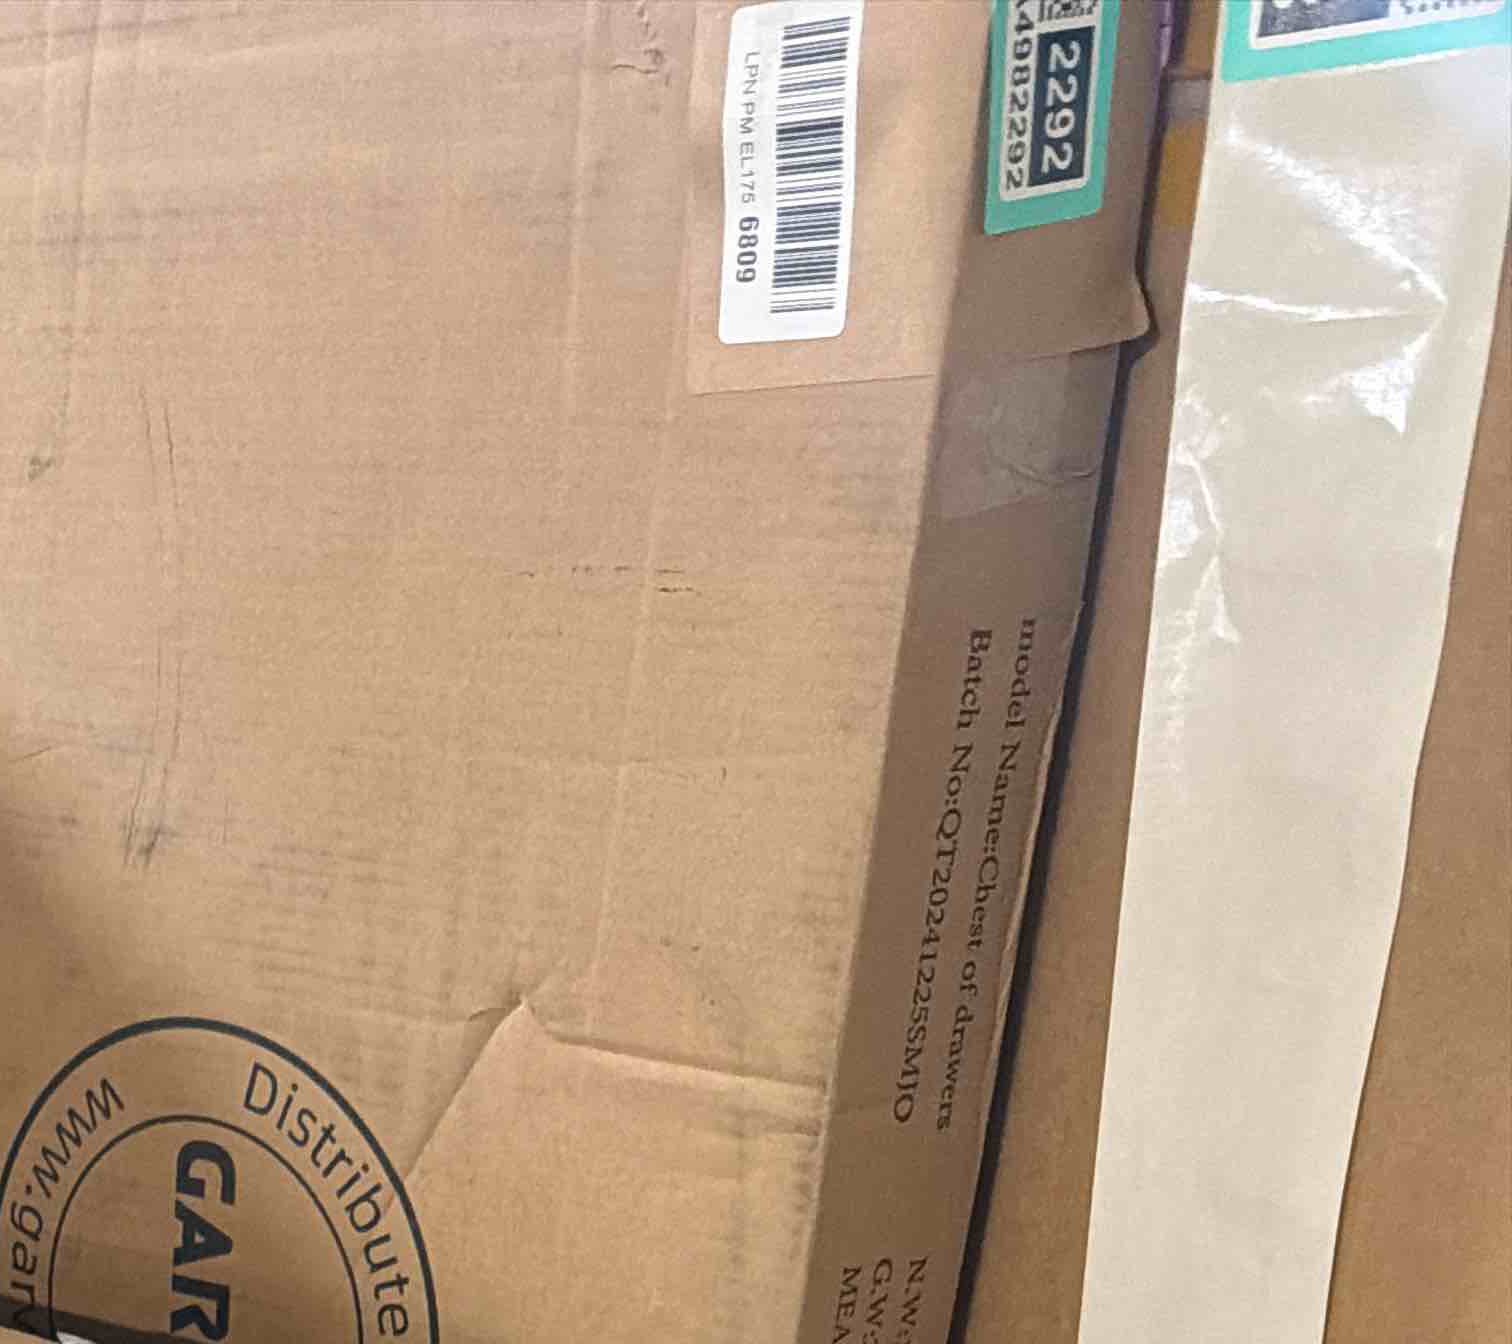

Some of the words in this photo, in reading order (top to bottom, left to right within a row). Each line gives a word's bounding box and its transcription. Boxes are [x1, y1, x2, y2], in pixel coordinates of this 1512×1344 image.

[1040, 38, 1082, 175] 2292
[735, 215, 759, 284] 6809
[958, 630, 992, 728] Batch
[1003, 617, 1035, 728] model
[960, 962, 979, 996] of
[935, 1005, 974, 1131] drawers
[8, 1077, 125, 1338] www.garv
